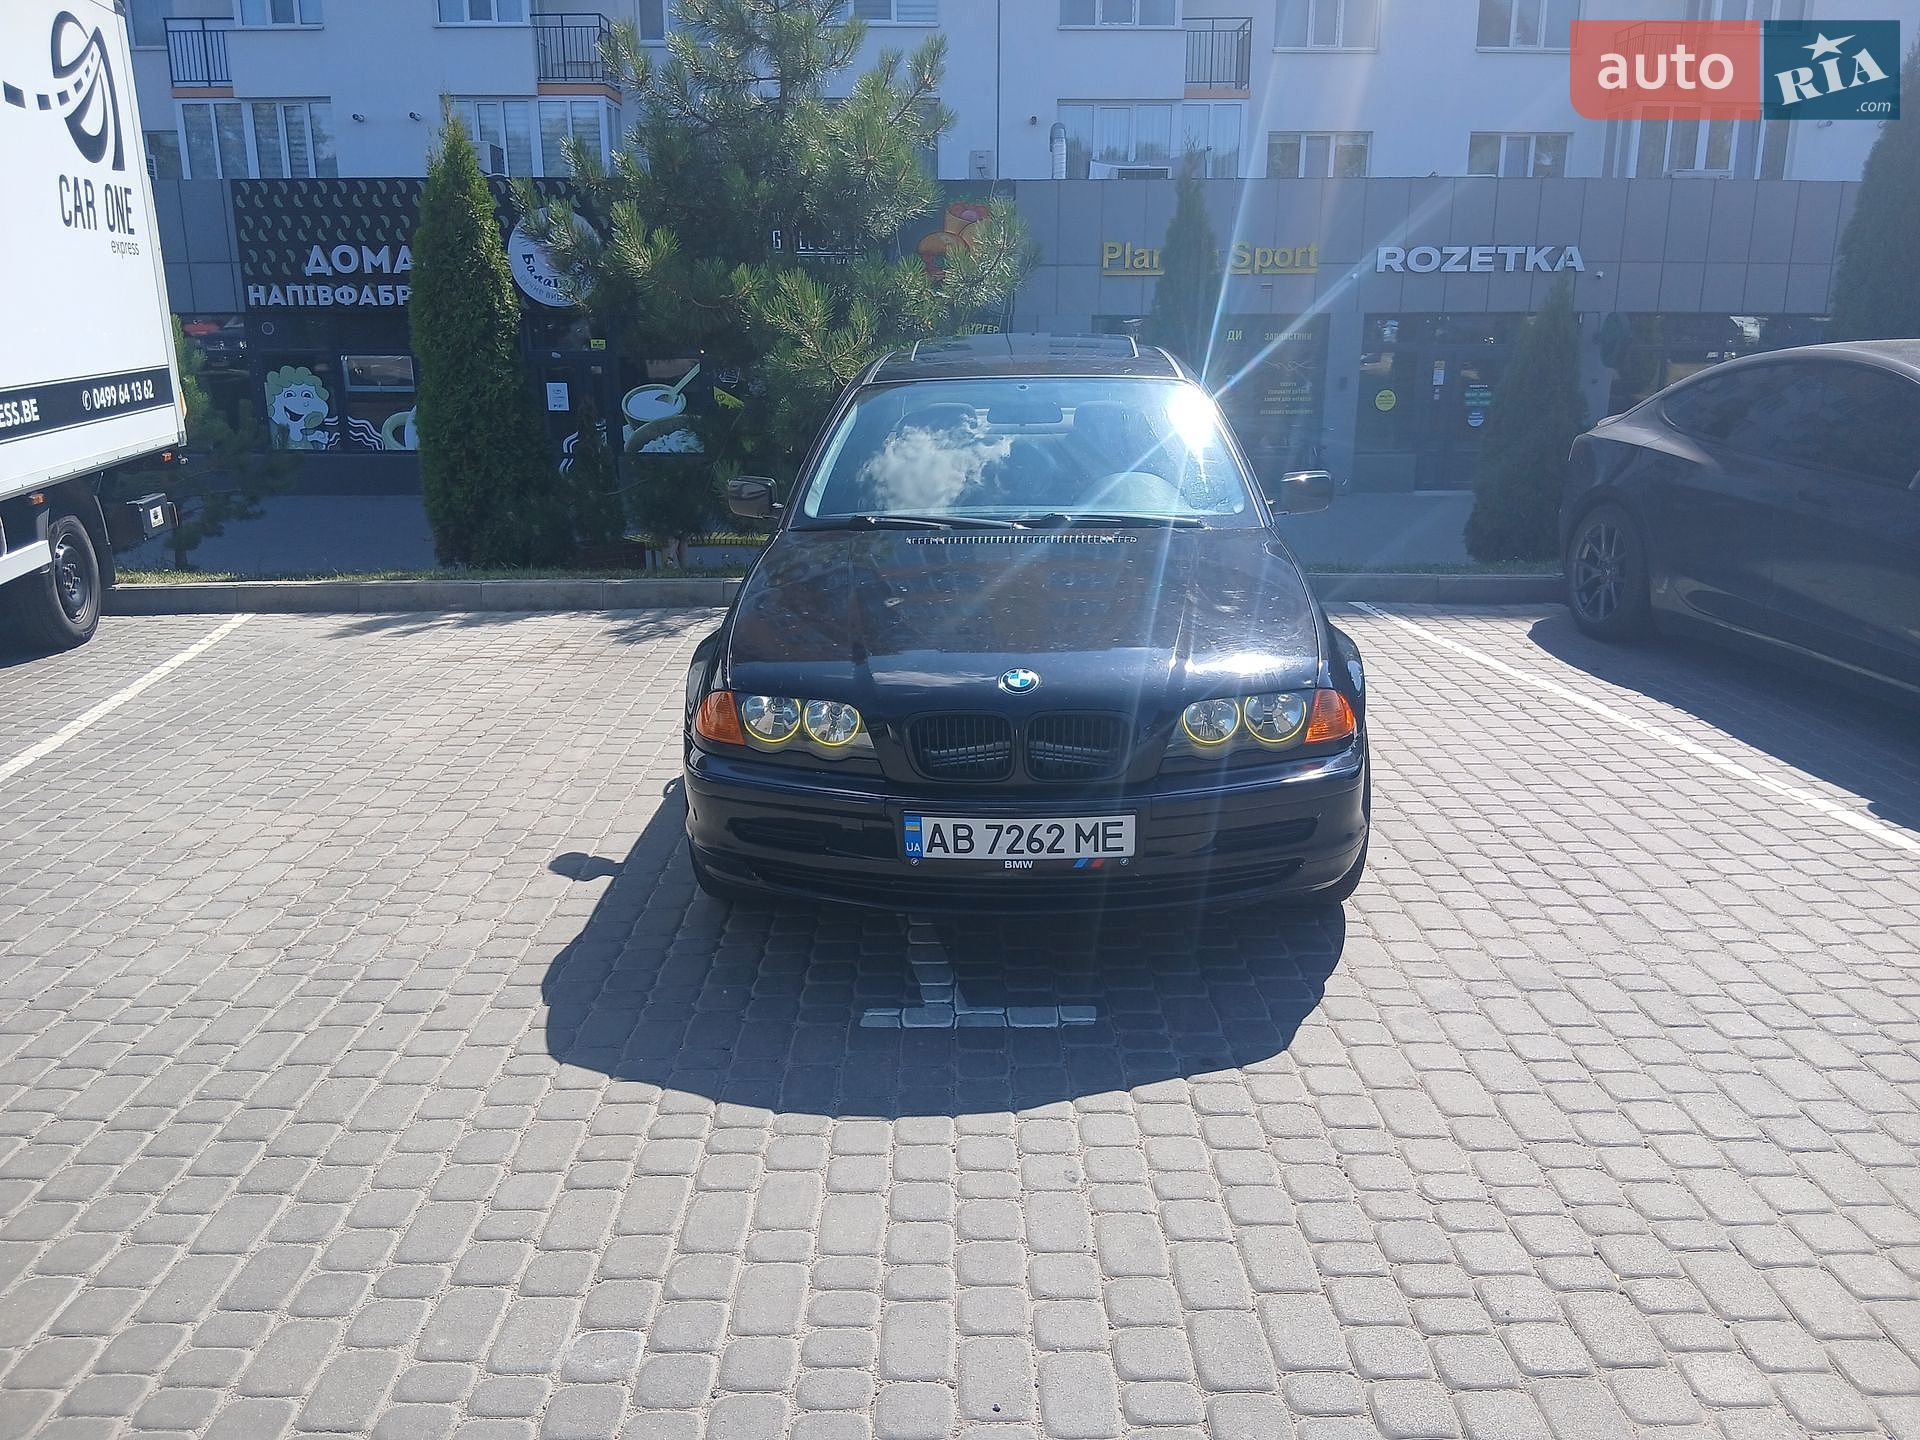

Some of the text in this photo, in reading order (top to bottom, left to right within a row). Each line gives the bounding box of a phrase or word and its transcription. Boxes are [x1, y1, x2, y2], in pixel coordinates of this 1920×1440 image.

[59, 174, 135, 235] CAR ONE
[111, 240, 139, 259] express
[1232, 240, 1318, 274] Sport
[1376, 246, 1585, 273] ROZETKA
[92, 379, 154, 410] 0499 64 13 62
[906, 842, 921, 852] UA
[926, 821, 1124, 854] AB 7262 ME
[1004, 860, 1033, 869] BMW
